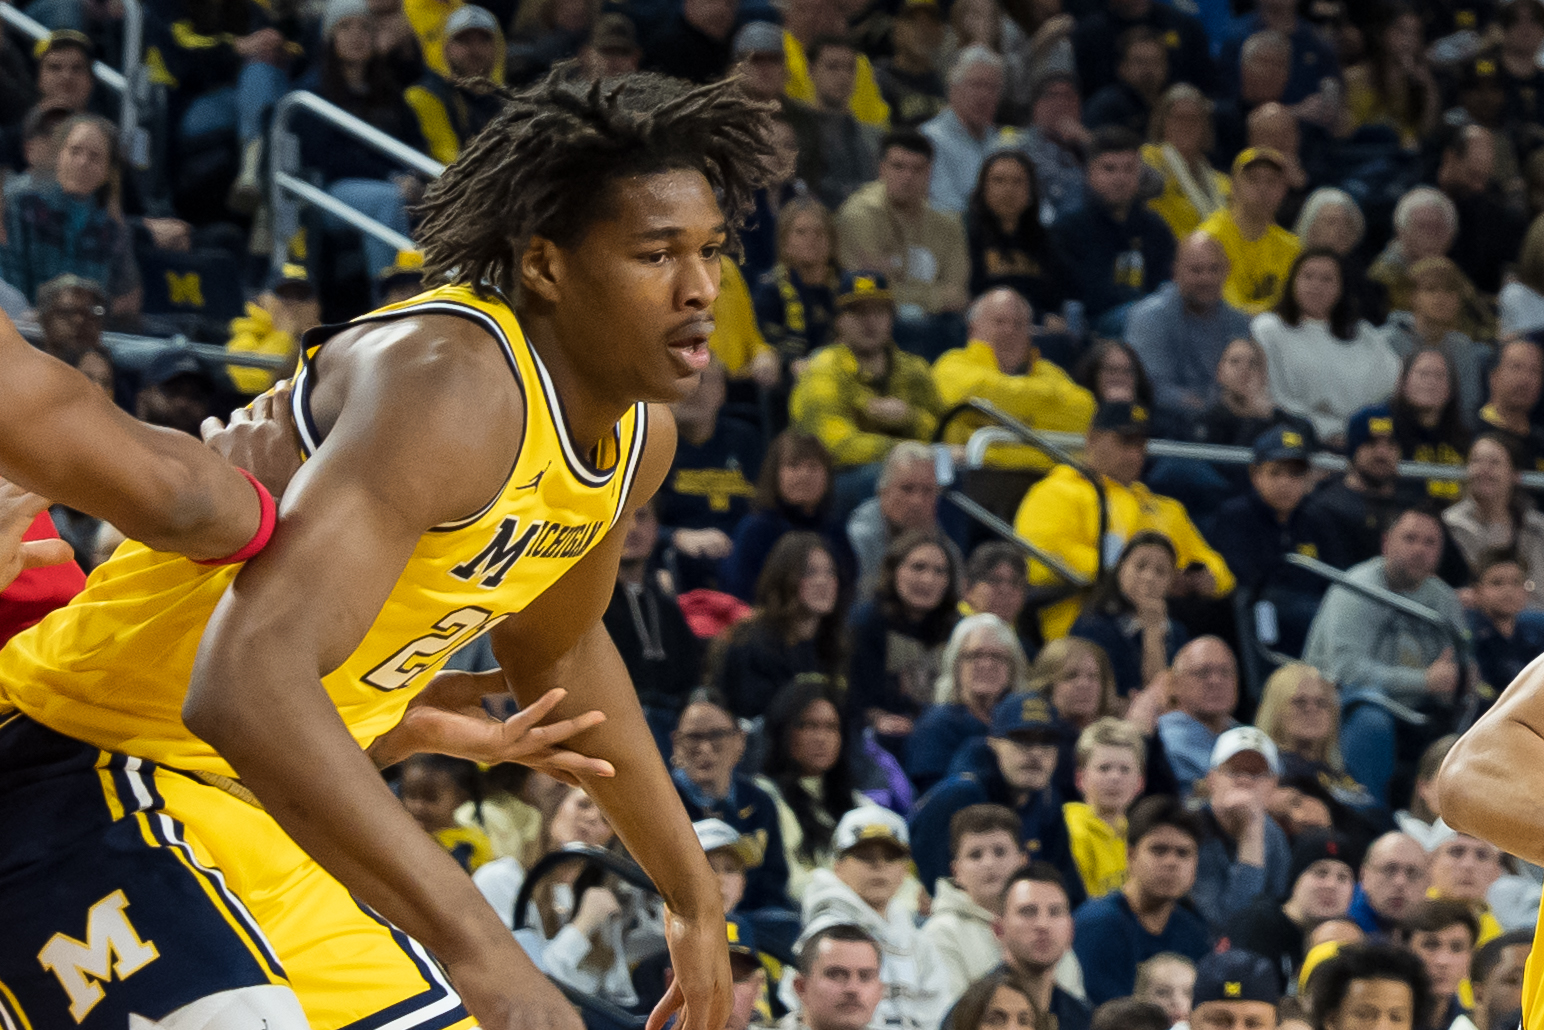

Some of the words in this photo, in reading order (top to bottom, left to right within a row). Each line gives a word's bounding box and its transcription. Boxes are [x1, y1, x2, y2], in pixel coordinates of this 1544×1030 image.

[447, 513, 605, 591] MICHIGAN
[359, 605, 518, 693] 2
[36, 888, 161, 1025] M
